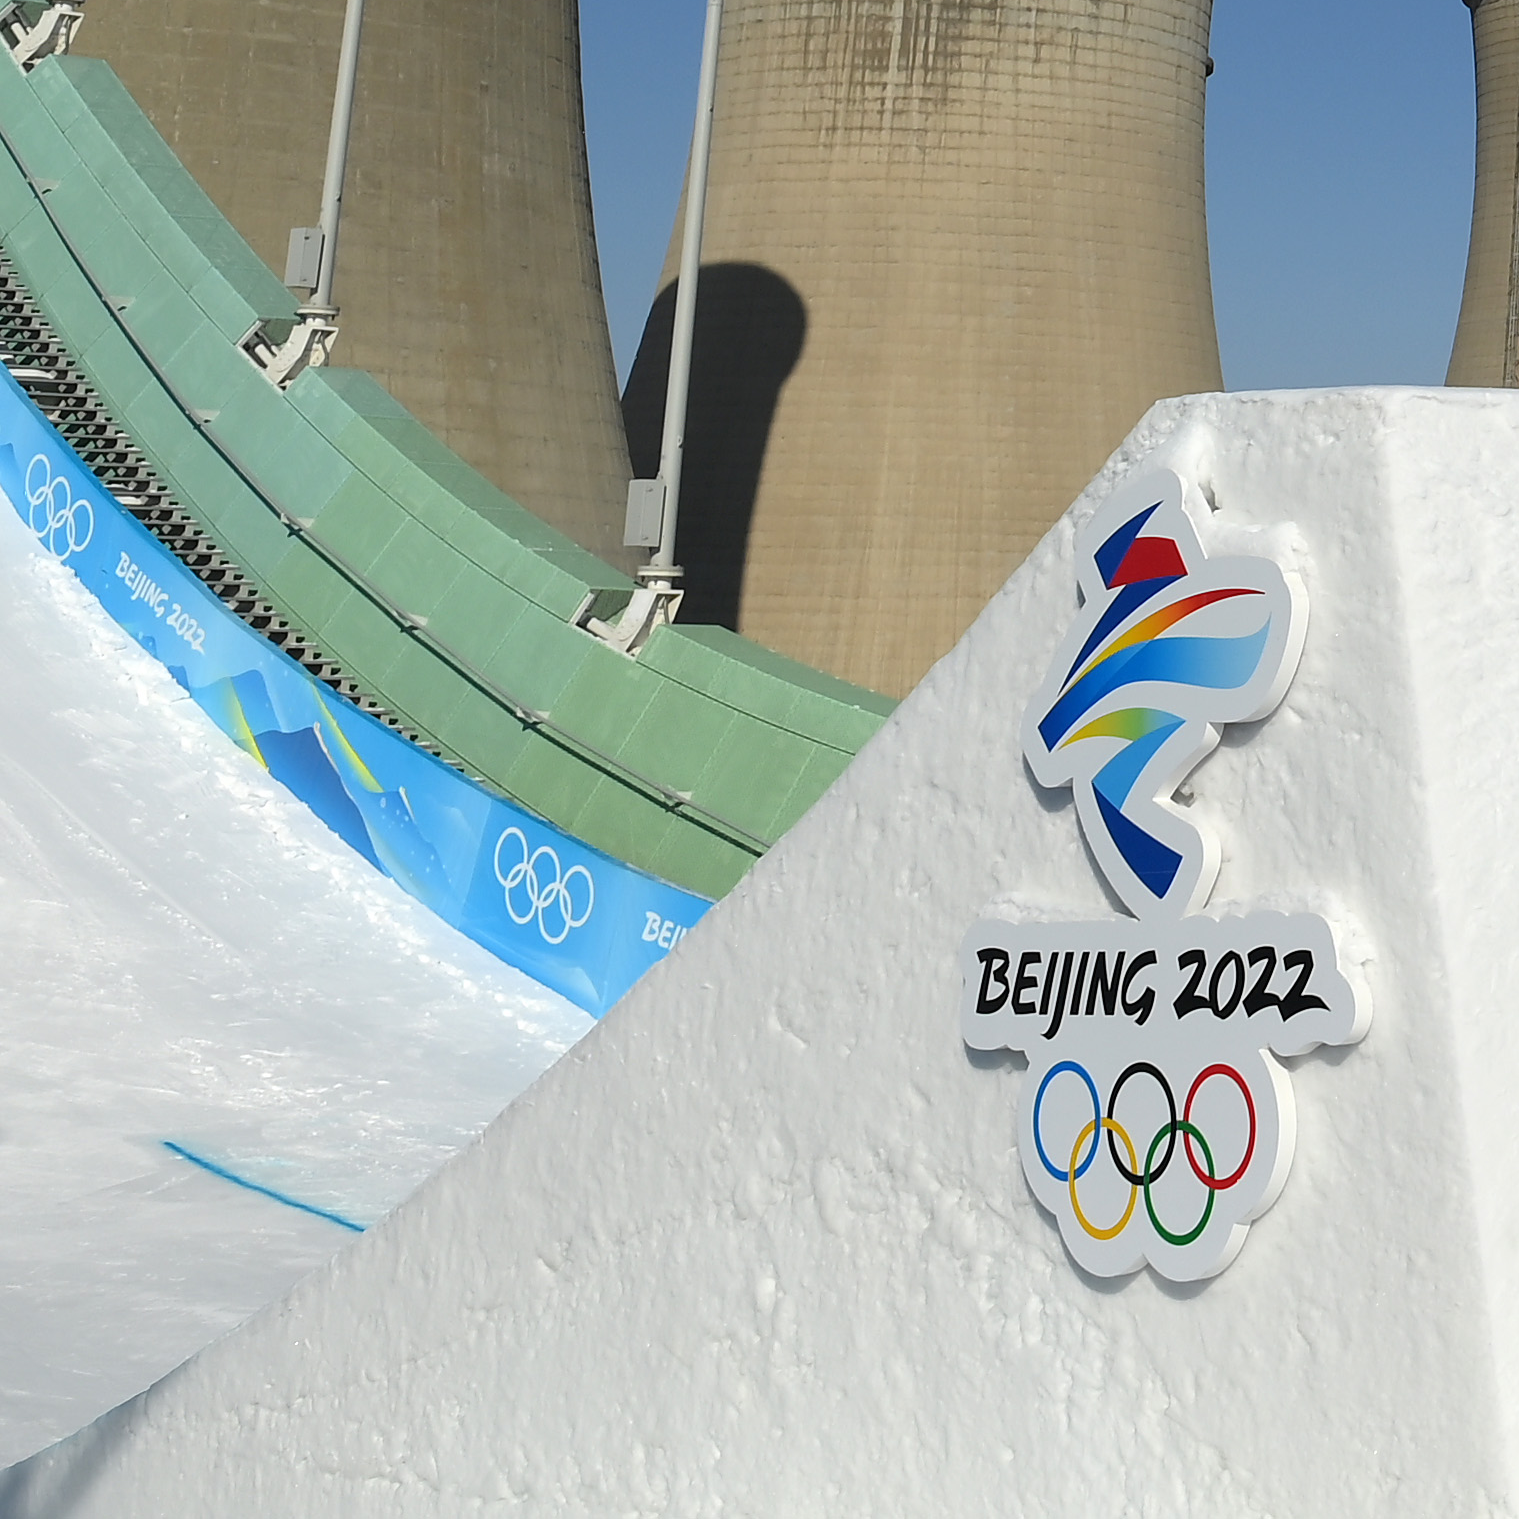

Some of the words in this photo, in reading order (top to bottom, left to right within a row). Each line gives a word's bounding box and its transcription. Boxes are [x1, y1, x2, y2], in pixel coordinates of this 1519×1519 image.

[115, 551, 170, 618] BEIJING
[166, 602, 206, 656] 2022
[975, 947, 1158, 1041] BEIJING
[1173, 945, 1331, 1023] 2022
